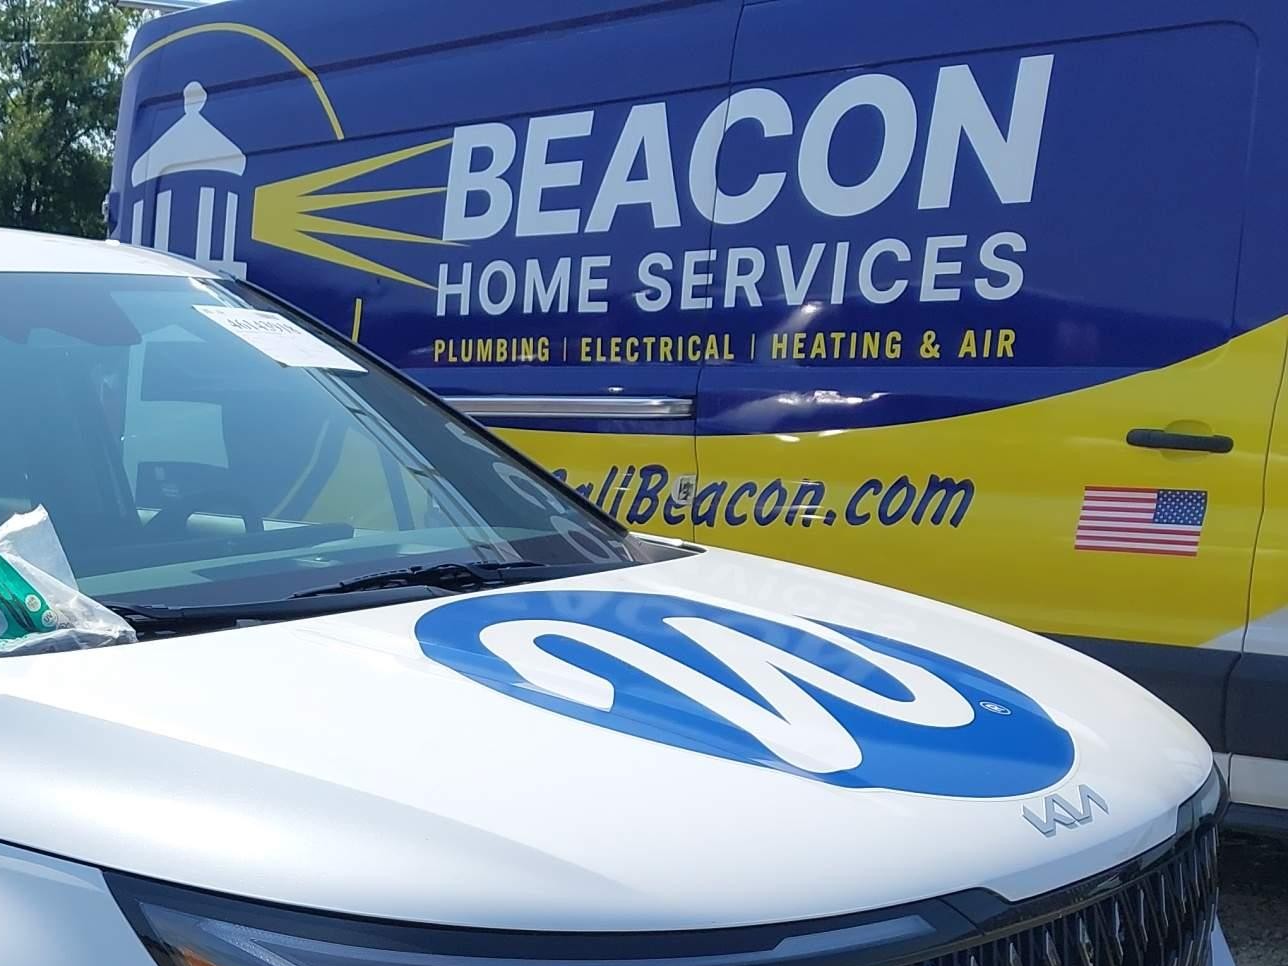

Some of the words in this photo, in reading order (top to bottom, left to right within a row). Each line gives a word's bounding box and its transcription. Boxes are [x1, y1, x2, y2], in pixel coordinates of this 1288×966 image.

[442, 54, 1054, 241] BEACON
[436, 256, 610, 316] HOME
[635, 232, 1028, 312] SERVICES
[433, 336, 550, 363] PLUMBING
[580, 333, 735, 362] ELECTRICAL
[771, 330, 903, 360] HEATING
[918, 329, 941, 360] &
[958, 328, 1017, 359] AIR
